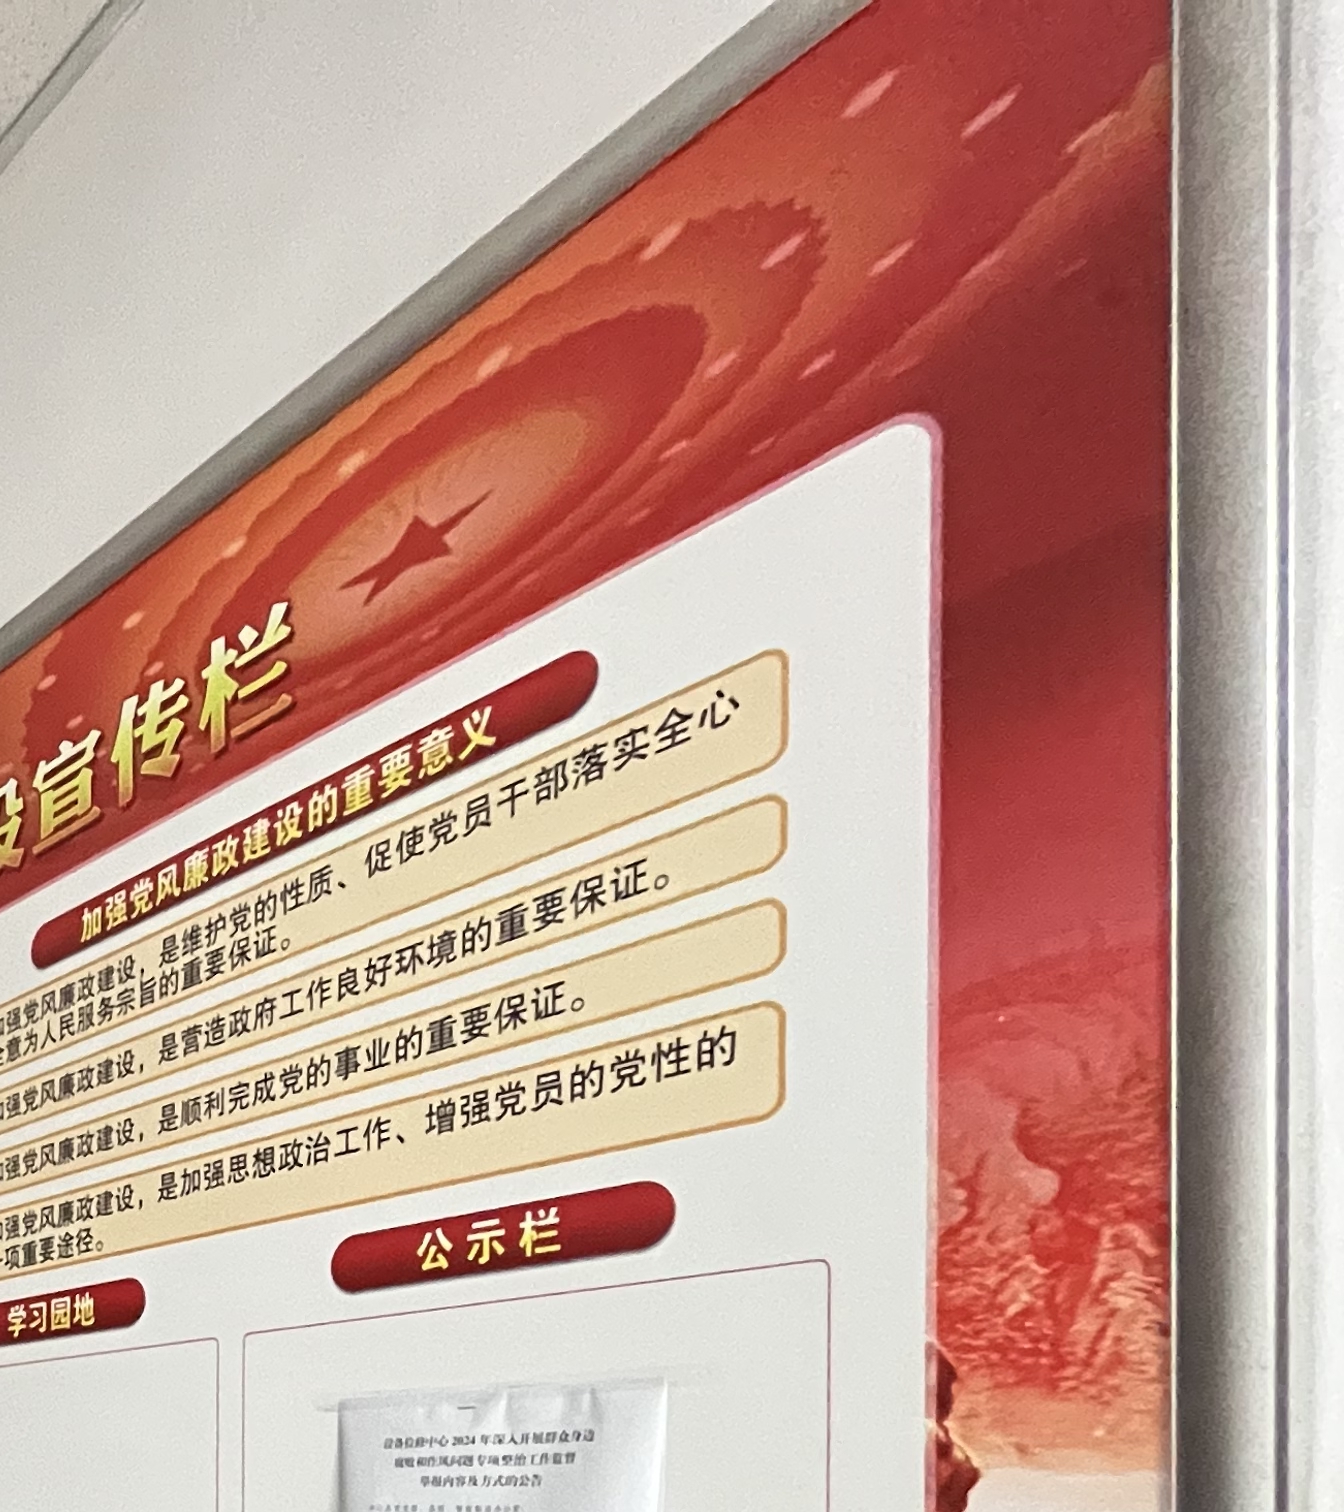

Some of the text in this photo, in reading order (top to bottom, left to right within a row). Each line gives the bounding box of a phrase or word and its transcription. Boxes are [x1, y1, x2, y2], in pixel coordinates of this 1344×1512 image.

[79, 704, 497, 943] 加强党风廉政建设的重要意义
[416, 1206, 563, 1271] 公示栏
[7, 1294, 96, 1339] 学习园地
